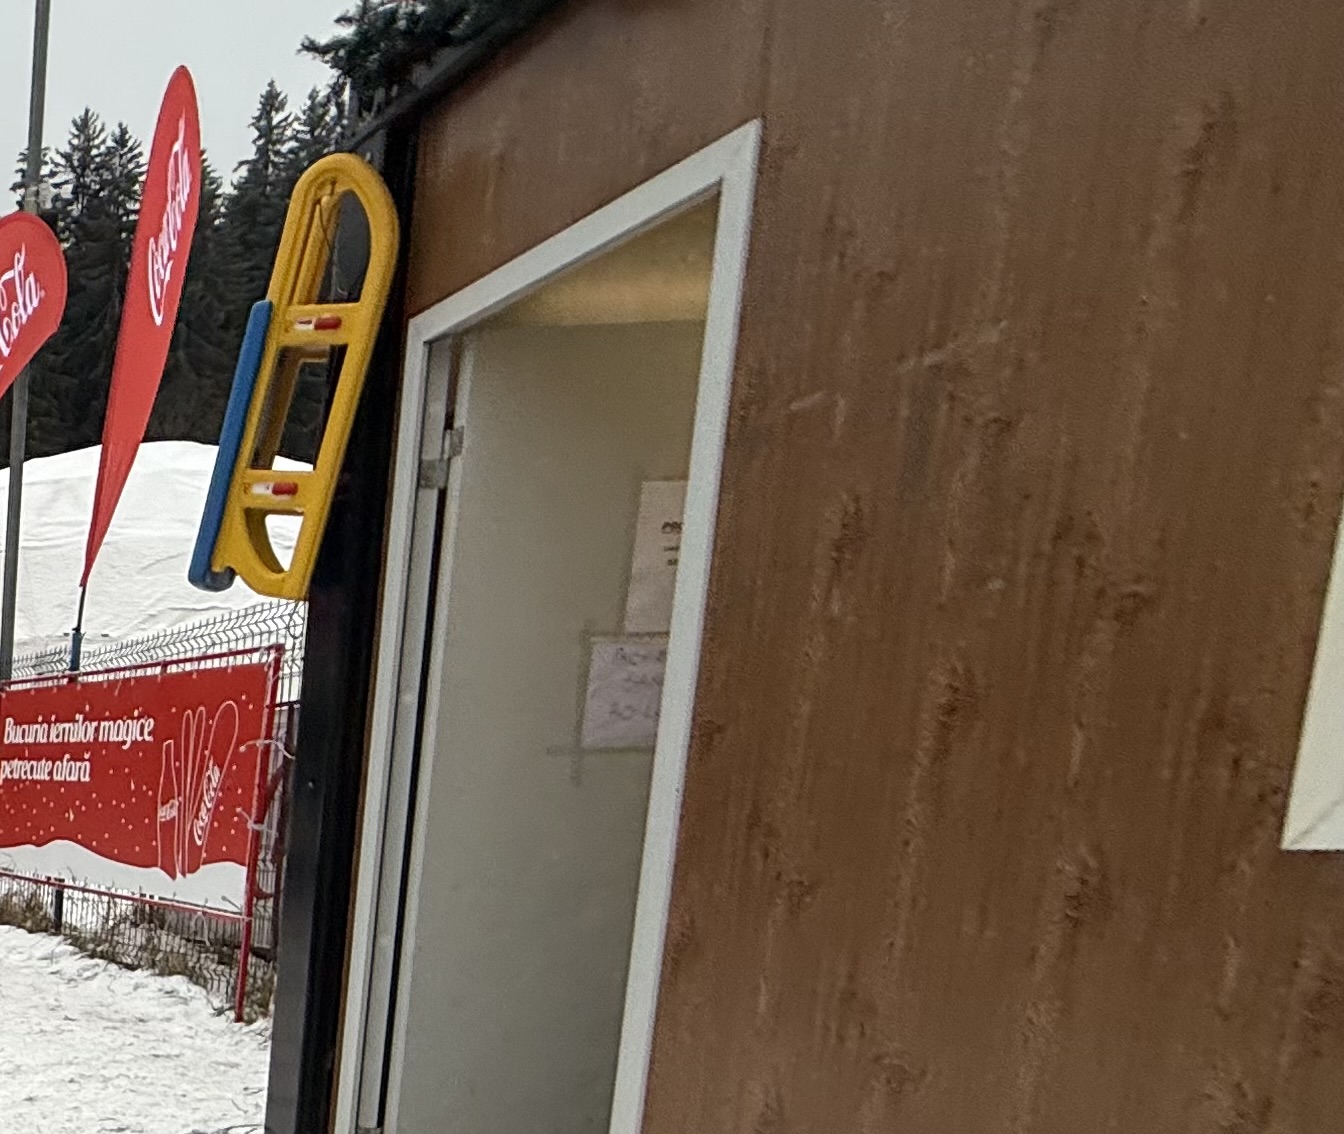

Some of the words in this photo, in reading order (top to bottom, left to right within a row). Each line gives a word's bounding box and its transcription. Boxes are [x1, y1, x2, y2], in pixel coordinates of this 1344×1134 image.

[3, 715, 49, 745] Bucuria
[49, 713, 98, 744] iernilor
[98, 709, 155, 750] magice
[53, 751, 91, 782] afară
